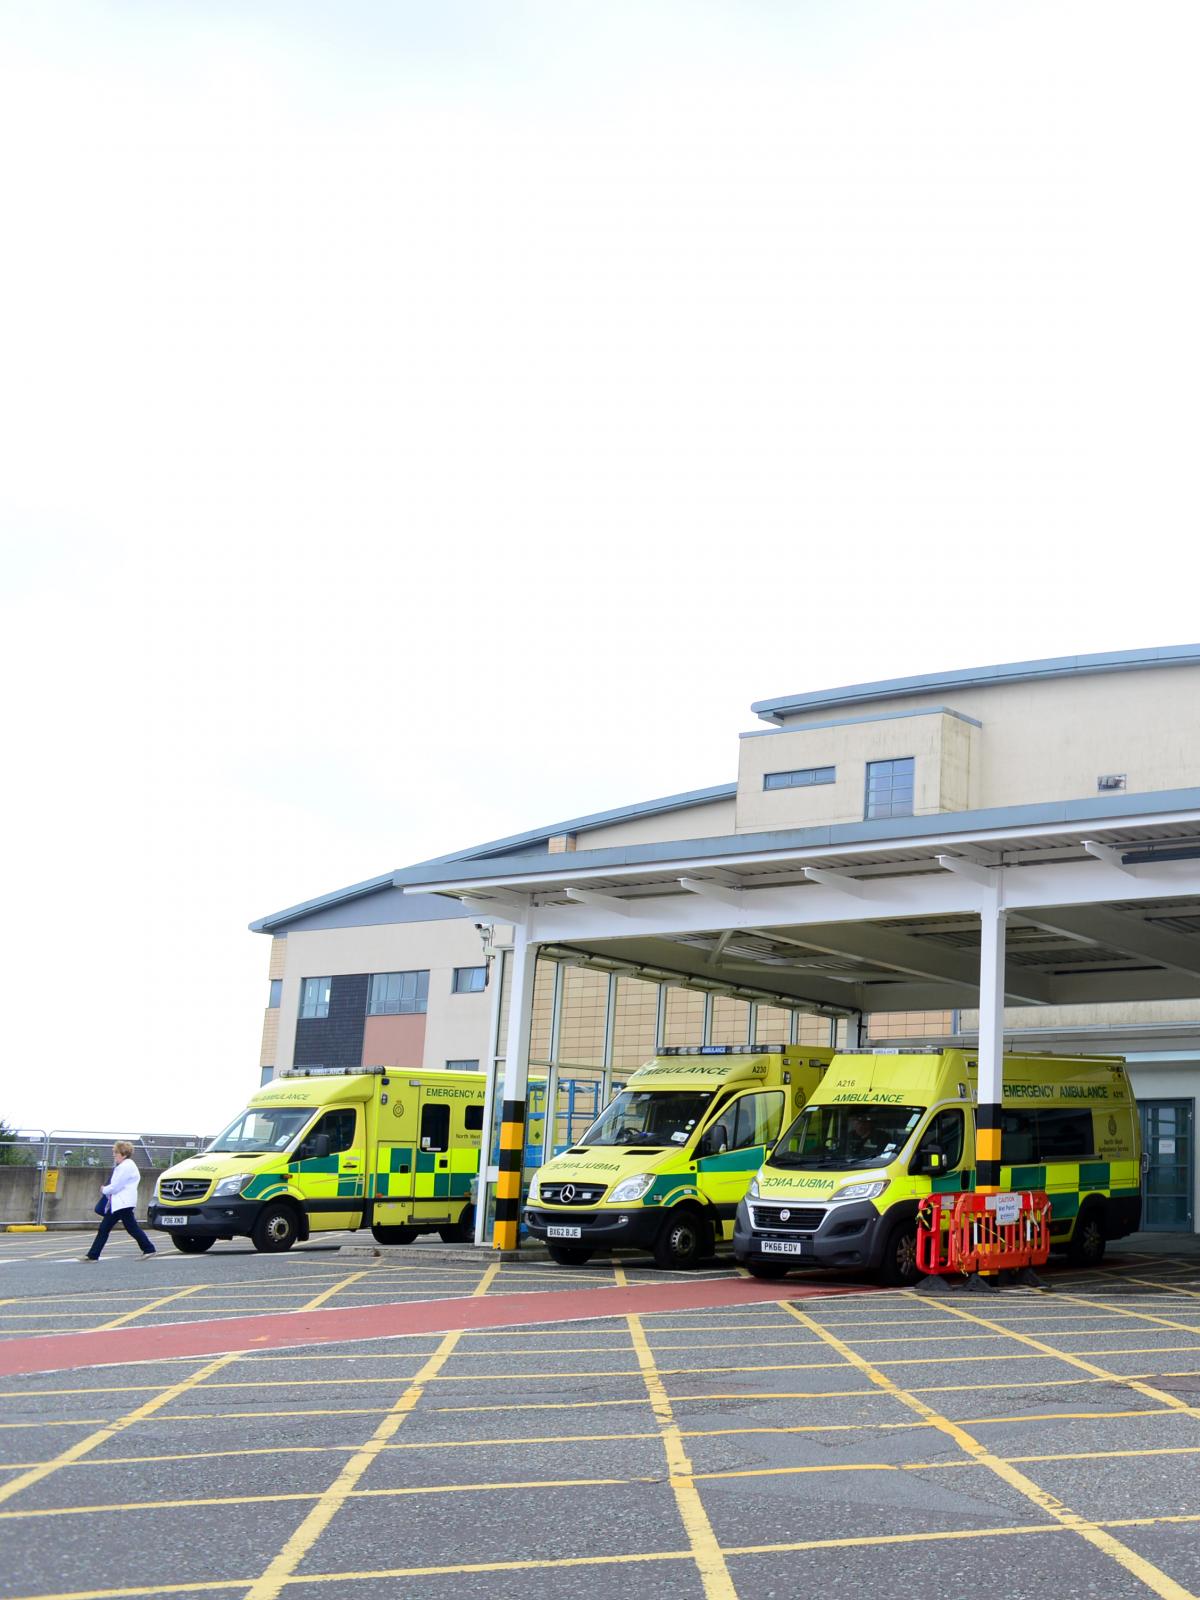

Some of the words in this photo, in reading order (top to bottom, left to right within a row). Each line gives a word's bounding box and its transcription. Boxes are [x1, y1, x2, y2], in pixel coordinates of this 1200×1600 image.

[637, 1066, 732, 1077] AMBULANCE
[751, 1066, 767, 1074] A230
[837, 1080, 855, 1088] A216
[426, 1088, 475, 1099] EMERGENCY
[1003, 1084, 1055, 1098] EMERGENCY
[1060, 1085, 1108, 1099] AMBULANCE
[832, 1092, 904, 1104] AMBULANCE
[764, 1242, 782, 1251] PK66
[784, 1243, 798, 1252] EDV
